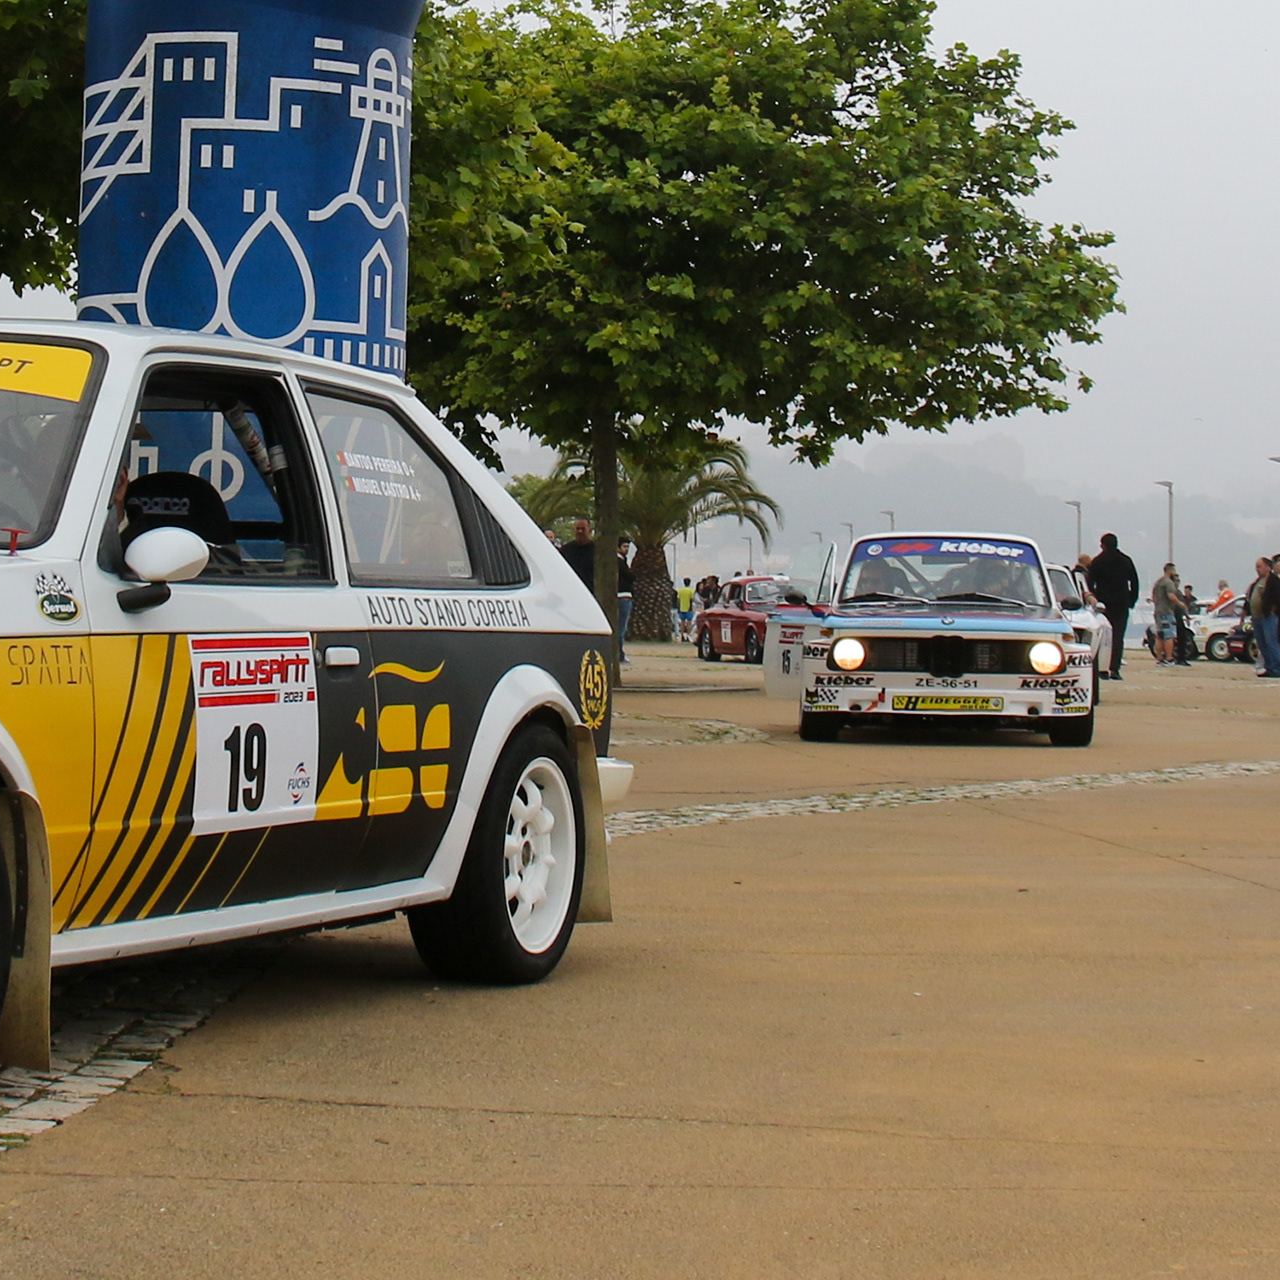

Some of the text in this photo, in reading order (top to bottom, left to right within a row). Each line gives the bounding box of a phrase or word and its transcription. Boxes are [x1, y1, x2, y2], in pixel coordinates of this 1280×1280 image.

[343, 451, 374, 471] SANTOS
[380, 480, 410, 500] CASTRO
[366, 595, 532, 628] AUTO STAND CORREIA
[585, 664, 603, 699] 45
[915, 677, 979, 689] ZE-56-51
[283, 691, 304, 703] 2023
[223, 722, 267, 813] 19
[287, 776, 311, 791] FUCHS
